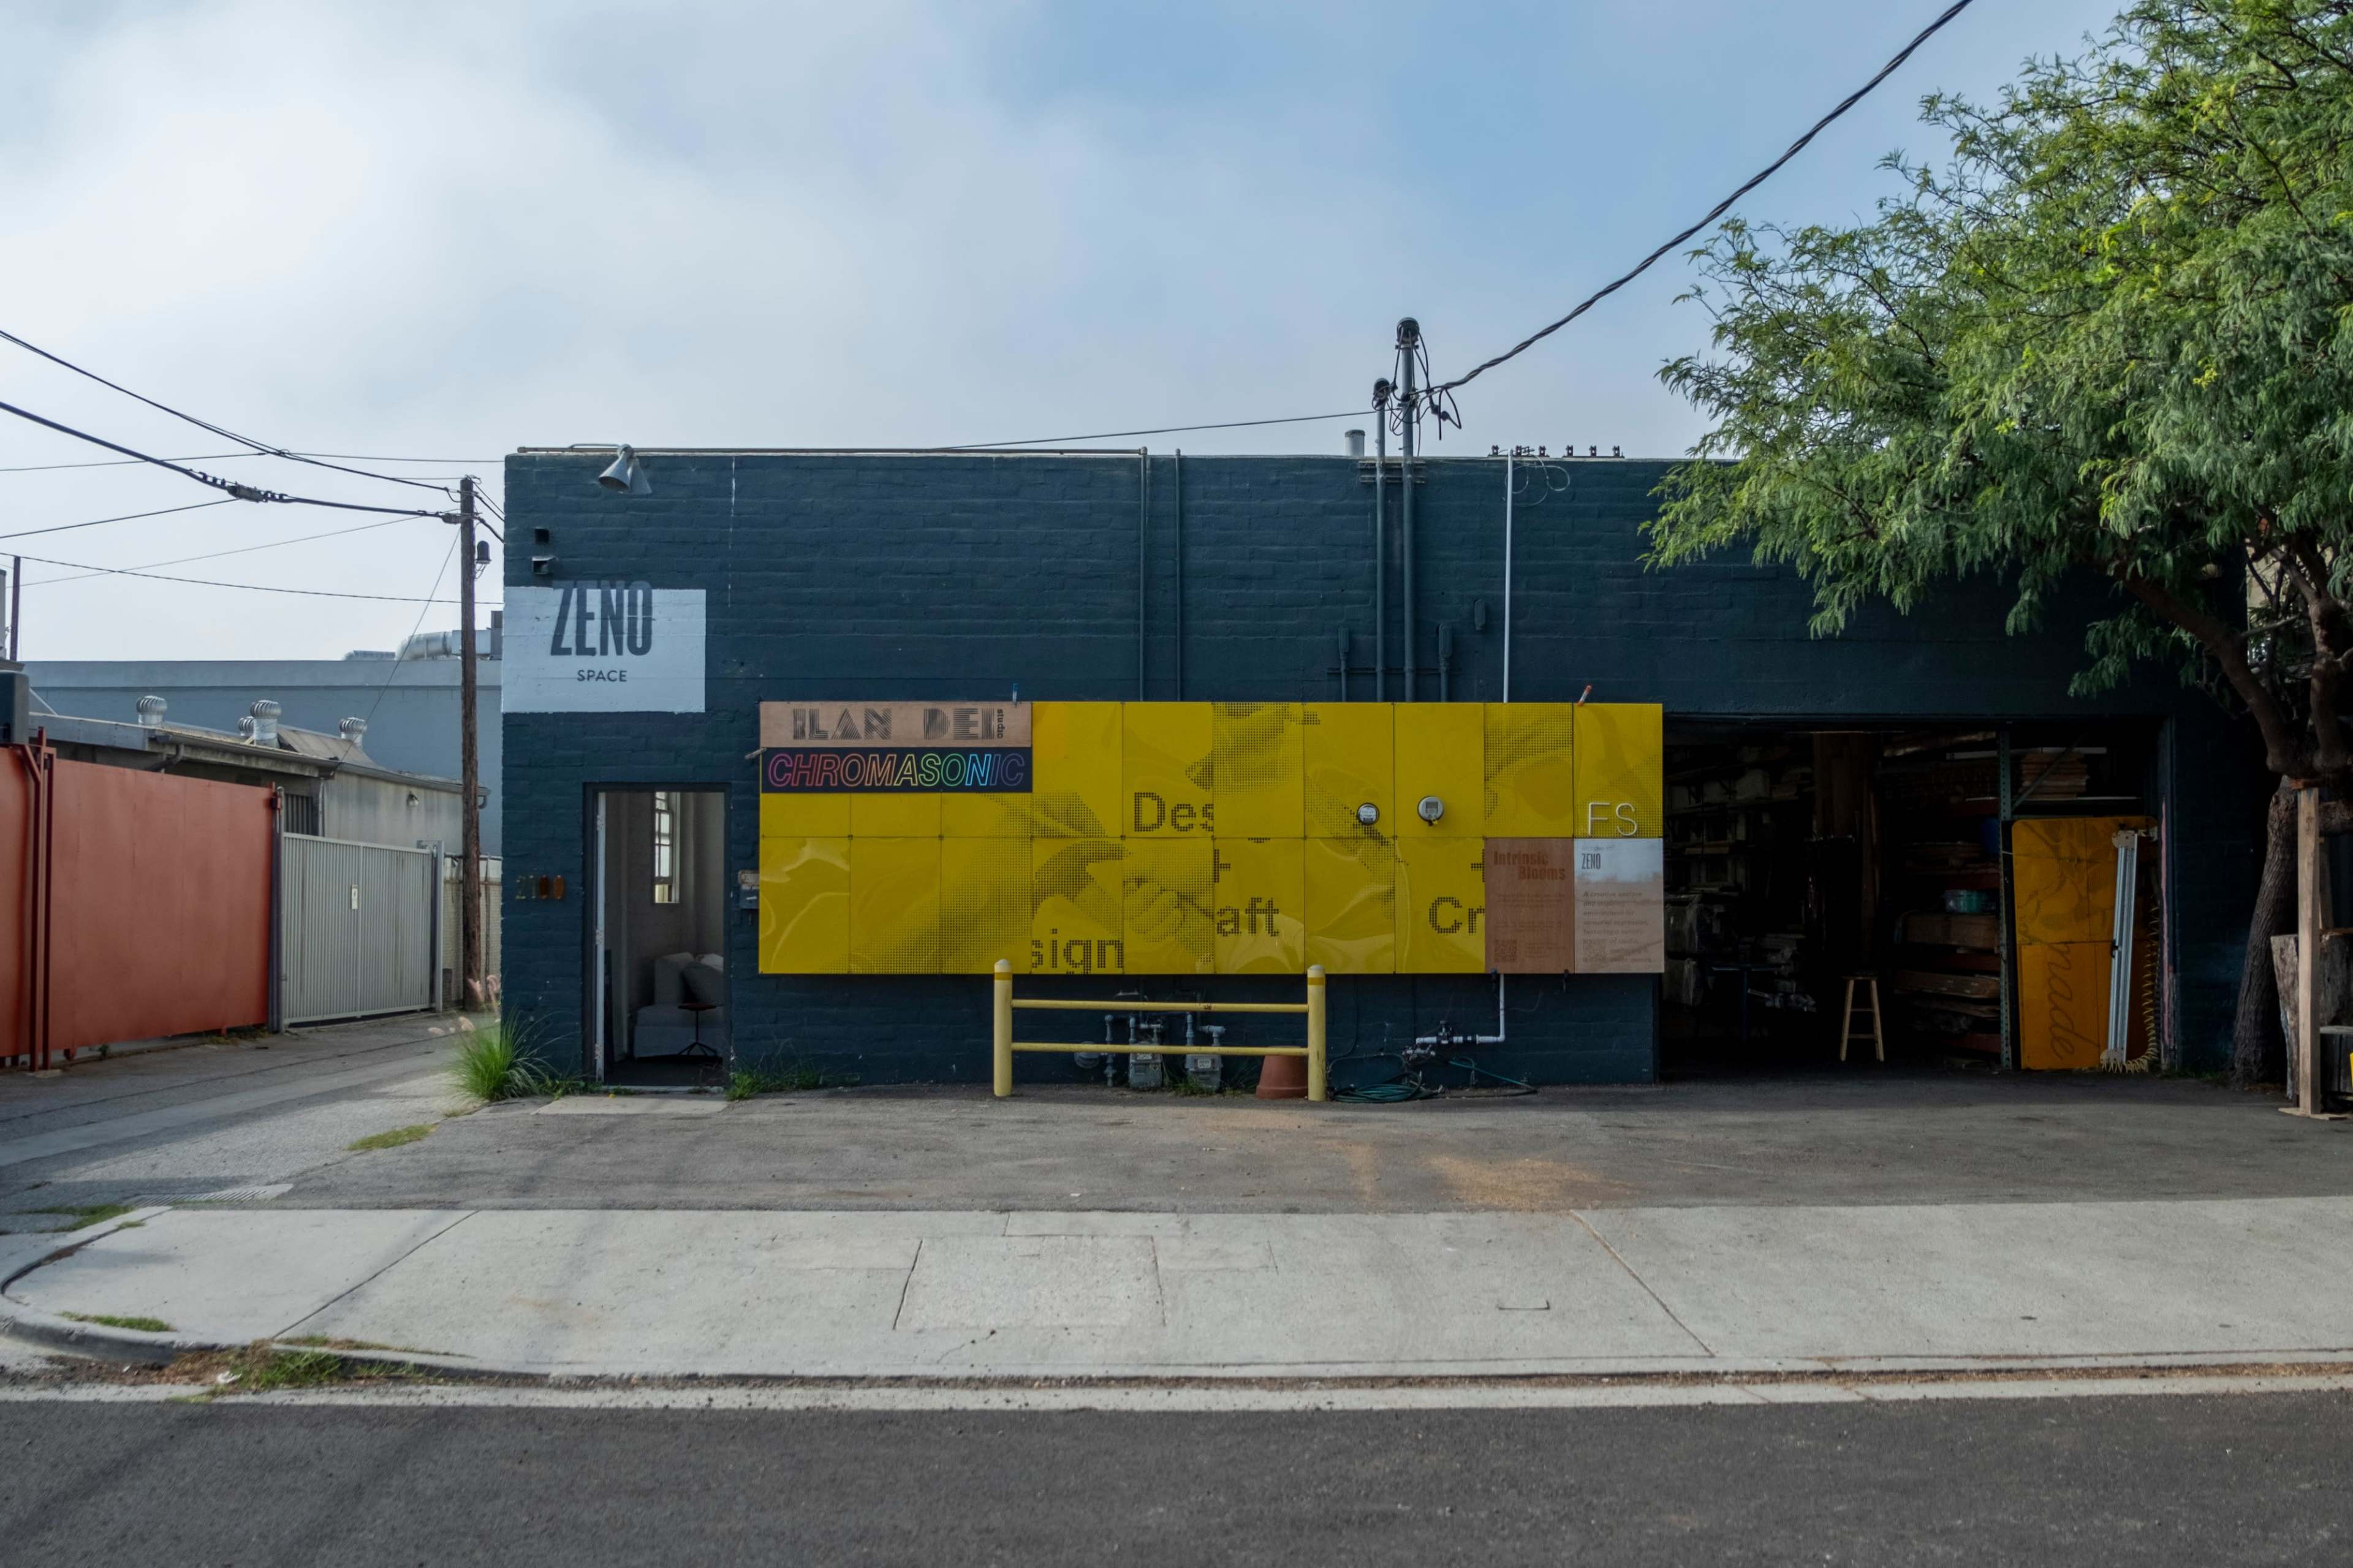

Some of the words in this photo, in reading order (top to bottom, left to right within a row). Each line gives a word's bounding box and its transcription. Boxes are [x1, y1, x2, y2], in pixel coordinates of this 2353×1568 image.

[550, 580, 653, 656] ZENO
[577, 669, 627, 682] SPACE
[793, 708, 892, 740] ILAN
[768, 753, 1025, 787] CHROMASONIC
[1588, 802, 1637, 836] FS
[1518, 865, 1566, 881] Blooms
[1581, 853, 1601, 869] ZENO
[1216, 897, 1279, 937] aft
[1428, 897, 1485, 934] Cr
